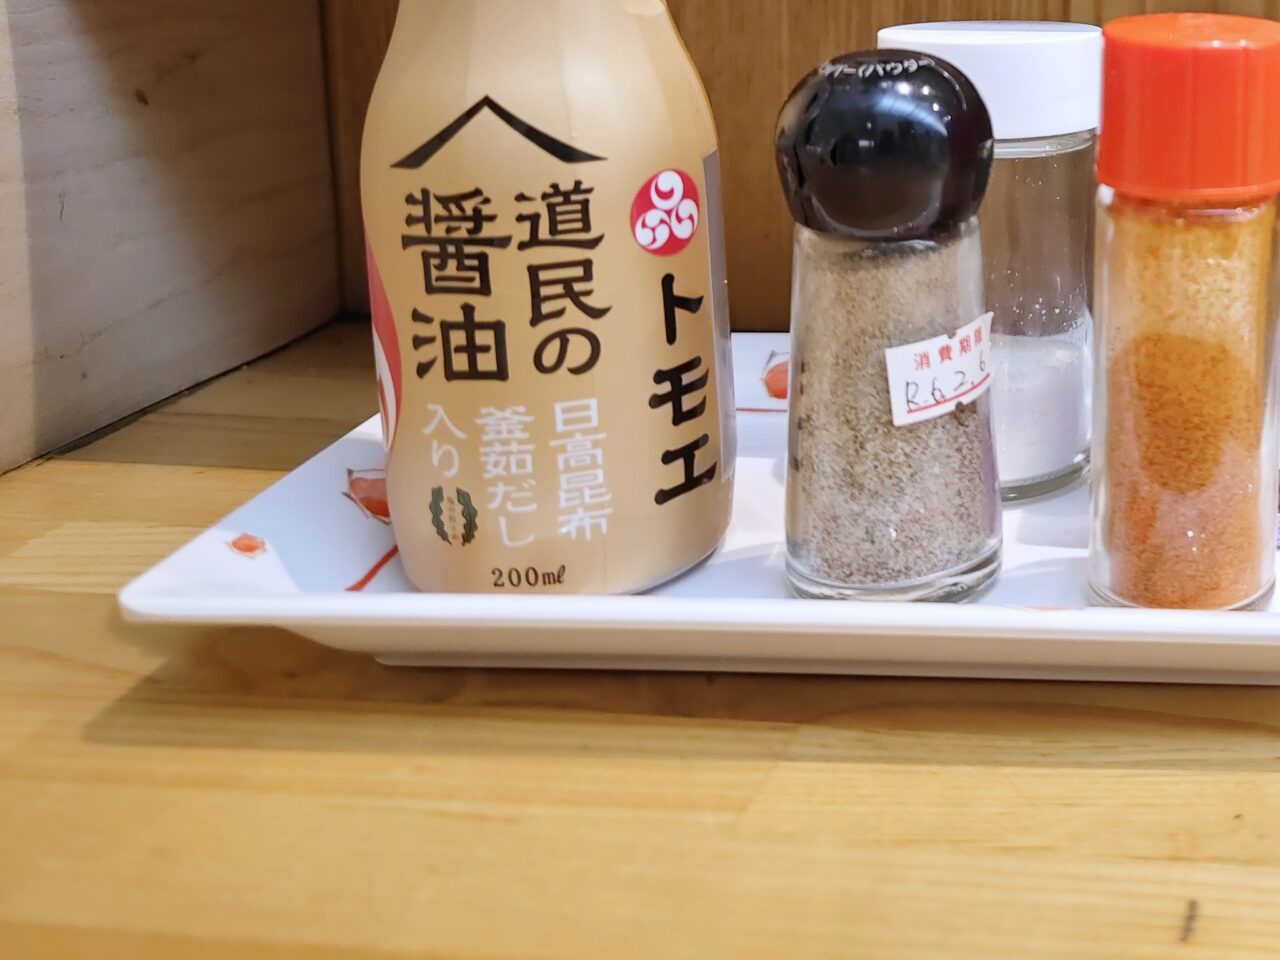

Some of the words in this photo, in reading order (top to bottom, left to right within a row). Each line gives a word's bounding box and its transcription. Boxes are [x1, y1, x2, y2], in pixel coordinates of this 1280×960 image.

[514, 179, 613, 376] 道民の
[421, 403, 468, 478] 入り
[648, 272, 717, 506] トモエ
[475, 404, 538, 549] 釜茹だし
[549, 397, 614, 541] 日高昆布
[491, 564, 566, 588] 200ml
